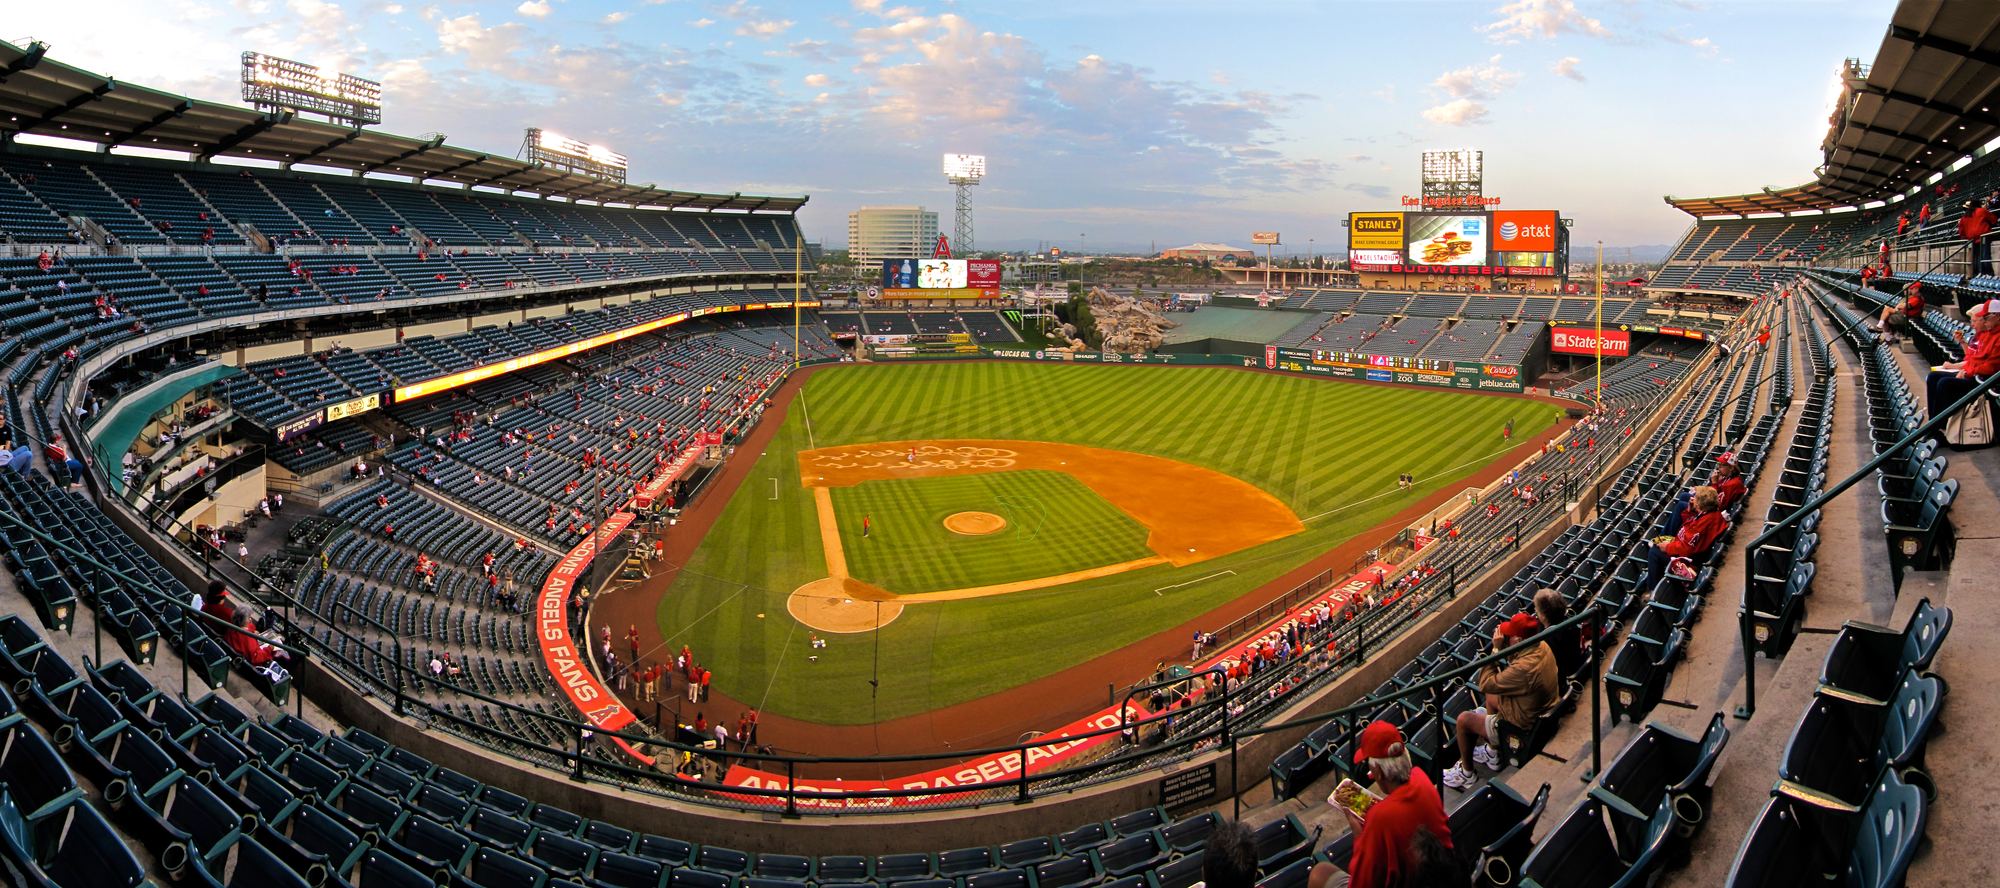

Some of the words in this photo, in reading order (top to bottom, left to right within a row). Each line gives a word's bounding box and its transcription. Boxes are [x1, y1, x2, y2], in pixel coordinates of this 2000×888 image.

[1358, 220, 1398, 229] STANLEY
[1521, 224, 1551, 238] at&t
[1391, 265, 1505, 275] BUDWEISER
[1479, 379, 1520, 389] jetblue.com
[542, 577, 567, 640] ANGELS
[549, 645, 599, 702] FANS
